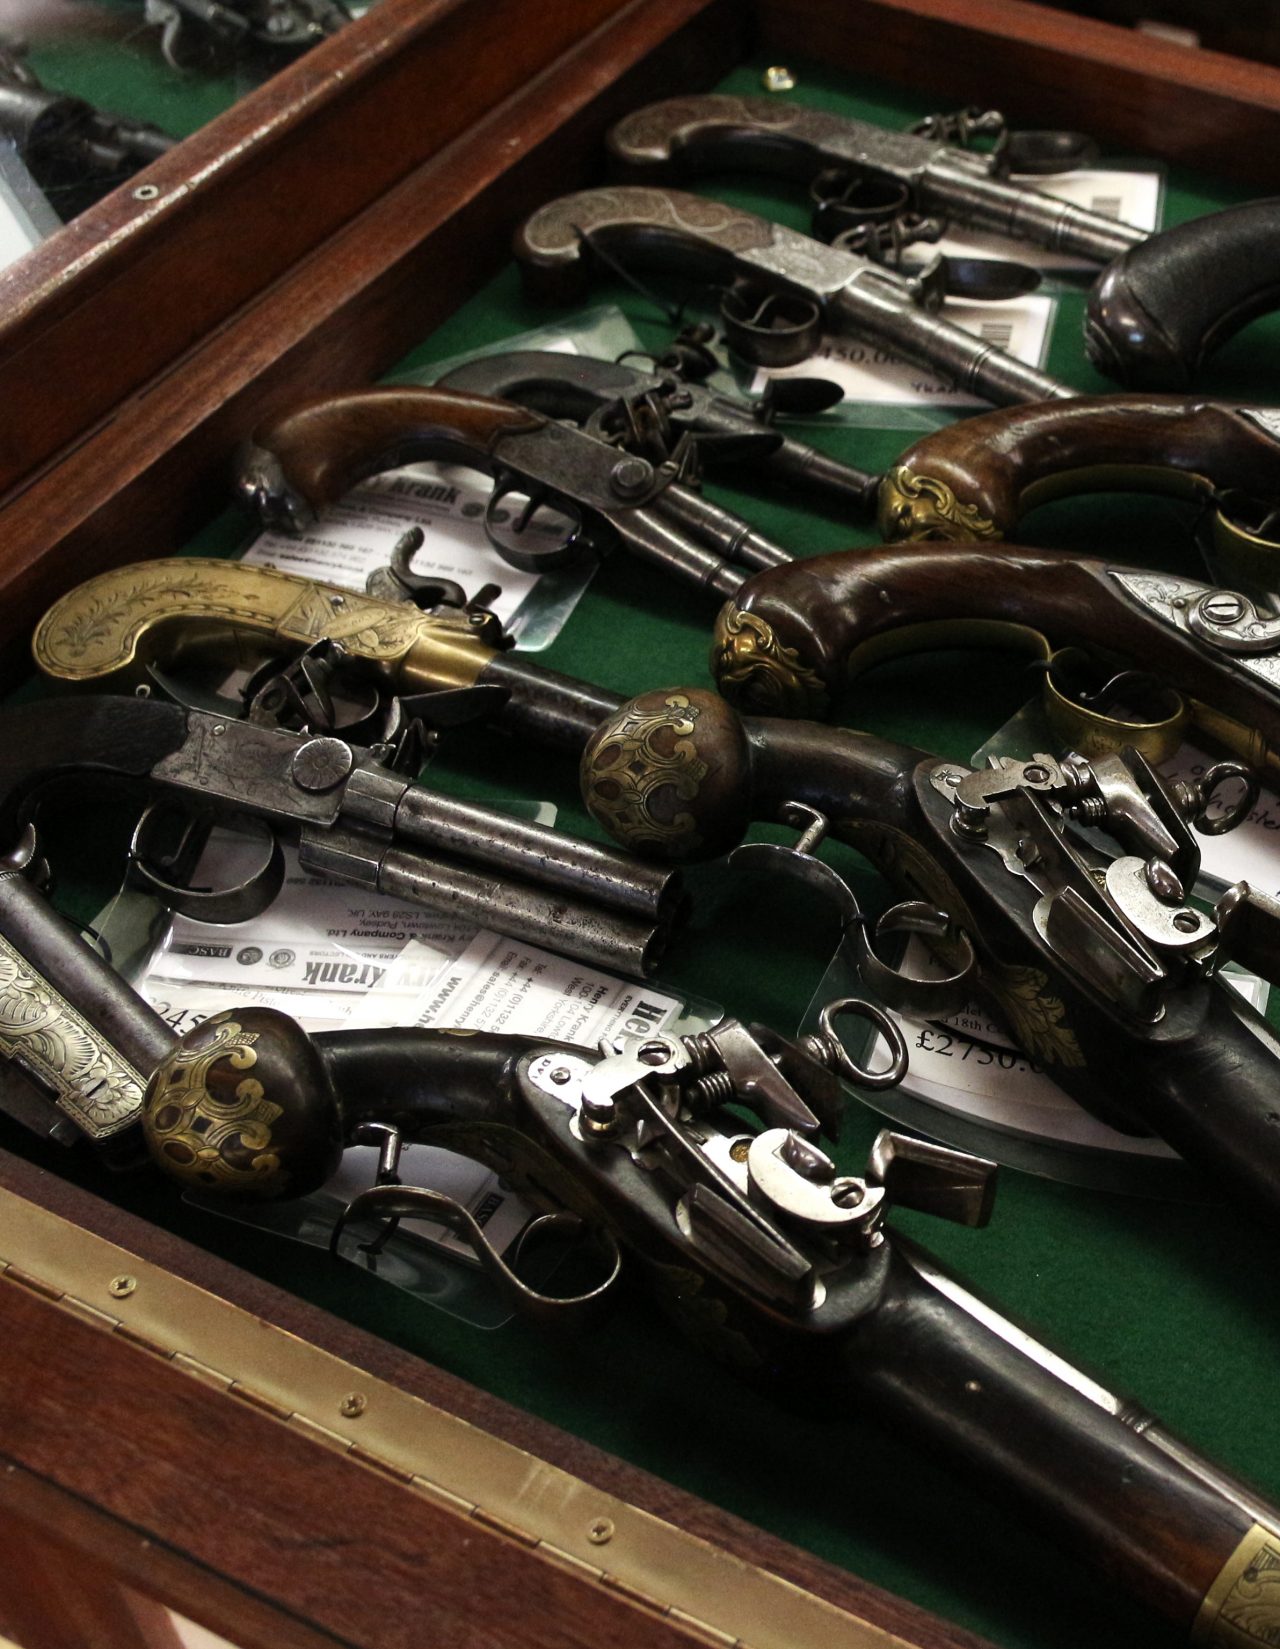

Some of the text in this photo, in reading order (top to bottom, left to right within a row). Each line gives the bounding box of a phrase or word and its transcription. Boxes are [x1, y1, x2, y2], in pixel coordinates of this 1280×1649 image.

[326, 929, 347, 937] Ltd.
[350, 929, 405, 940] Company
[188, 944, 228, 957] BASC
[302, 961, 386, 988] Krank
[563, 977, 584, 996] West
[563, 985, 608, 1041] Henry Krank
[954, 1017, 982, 1032] 18th
